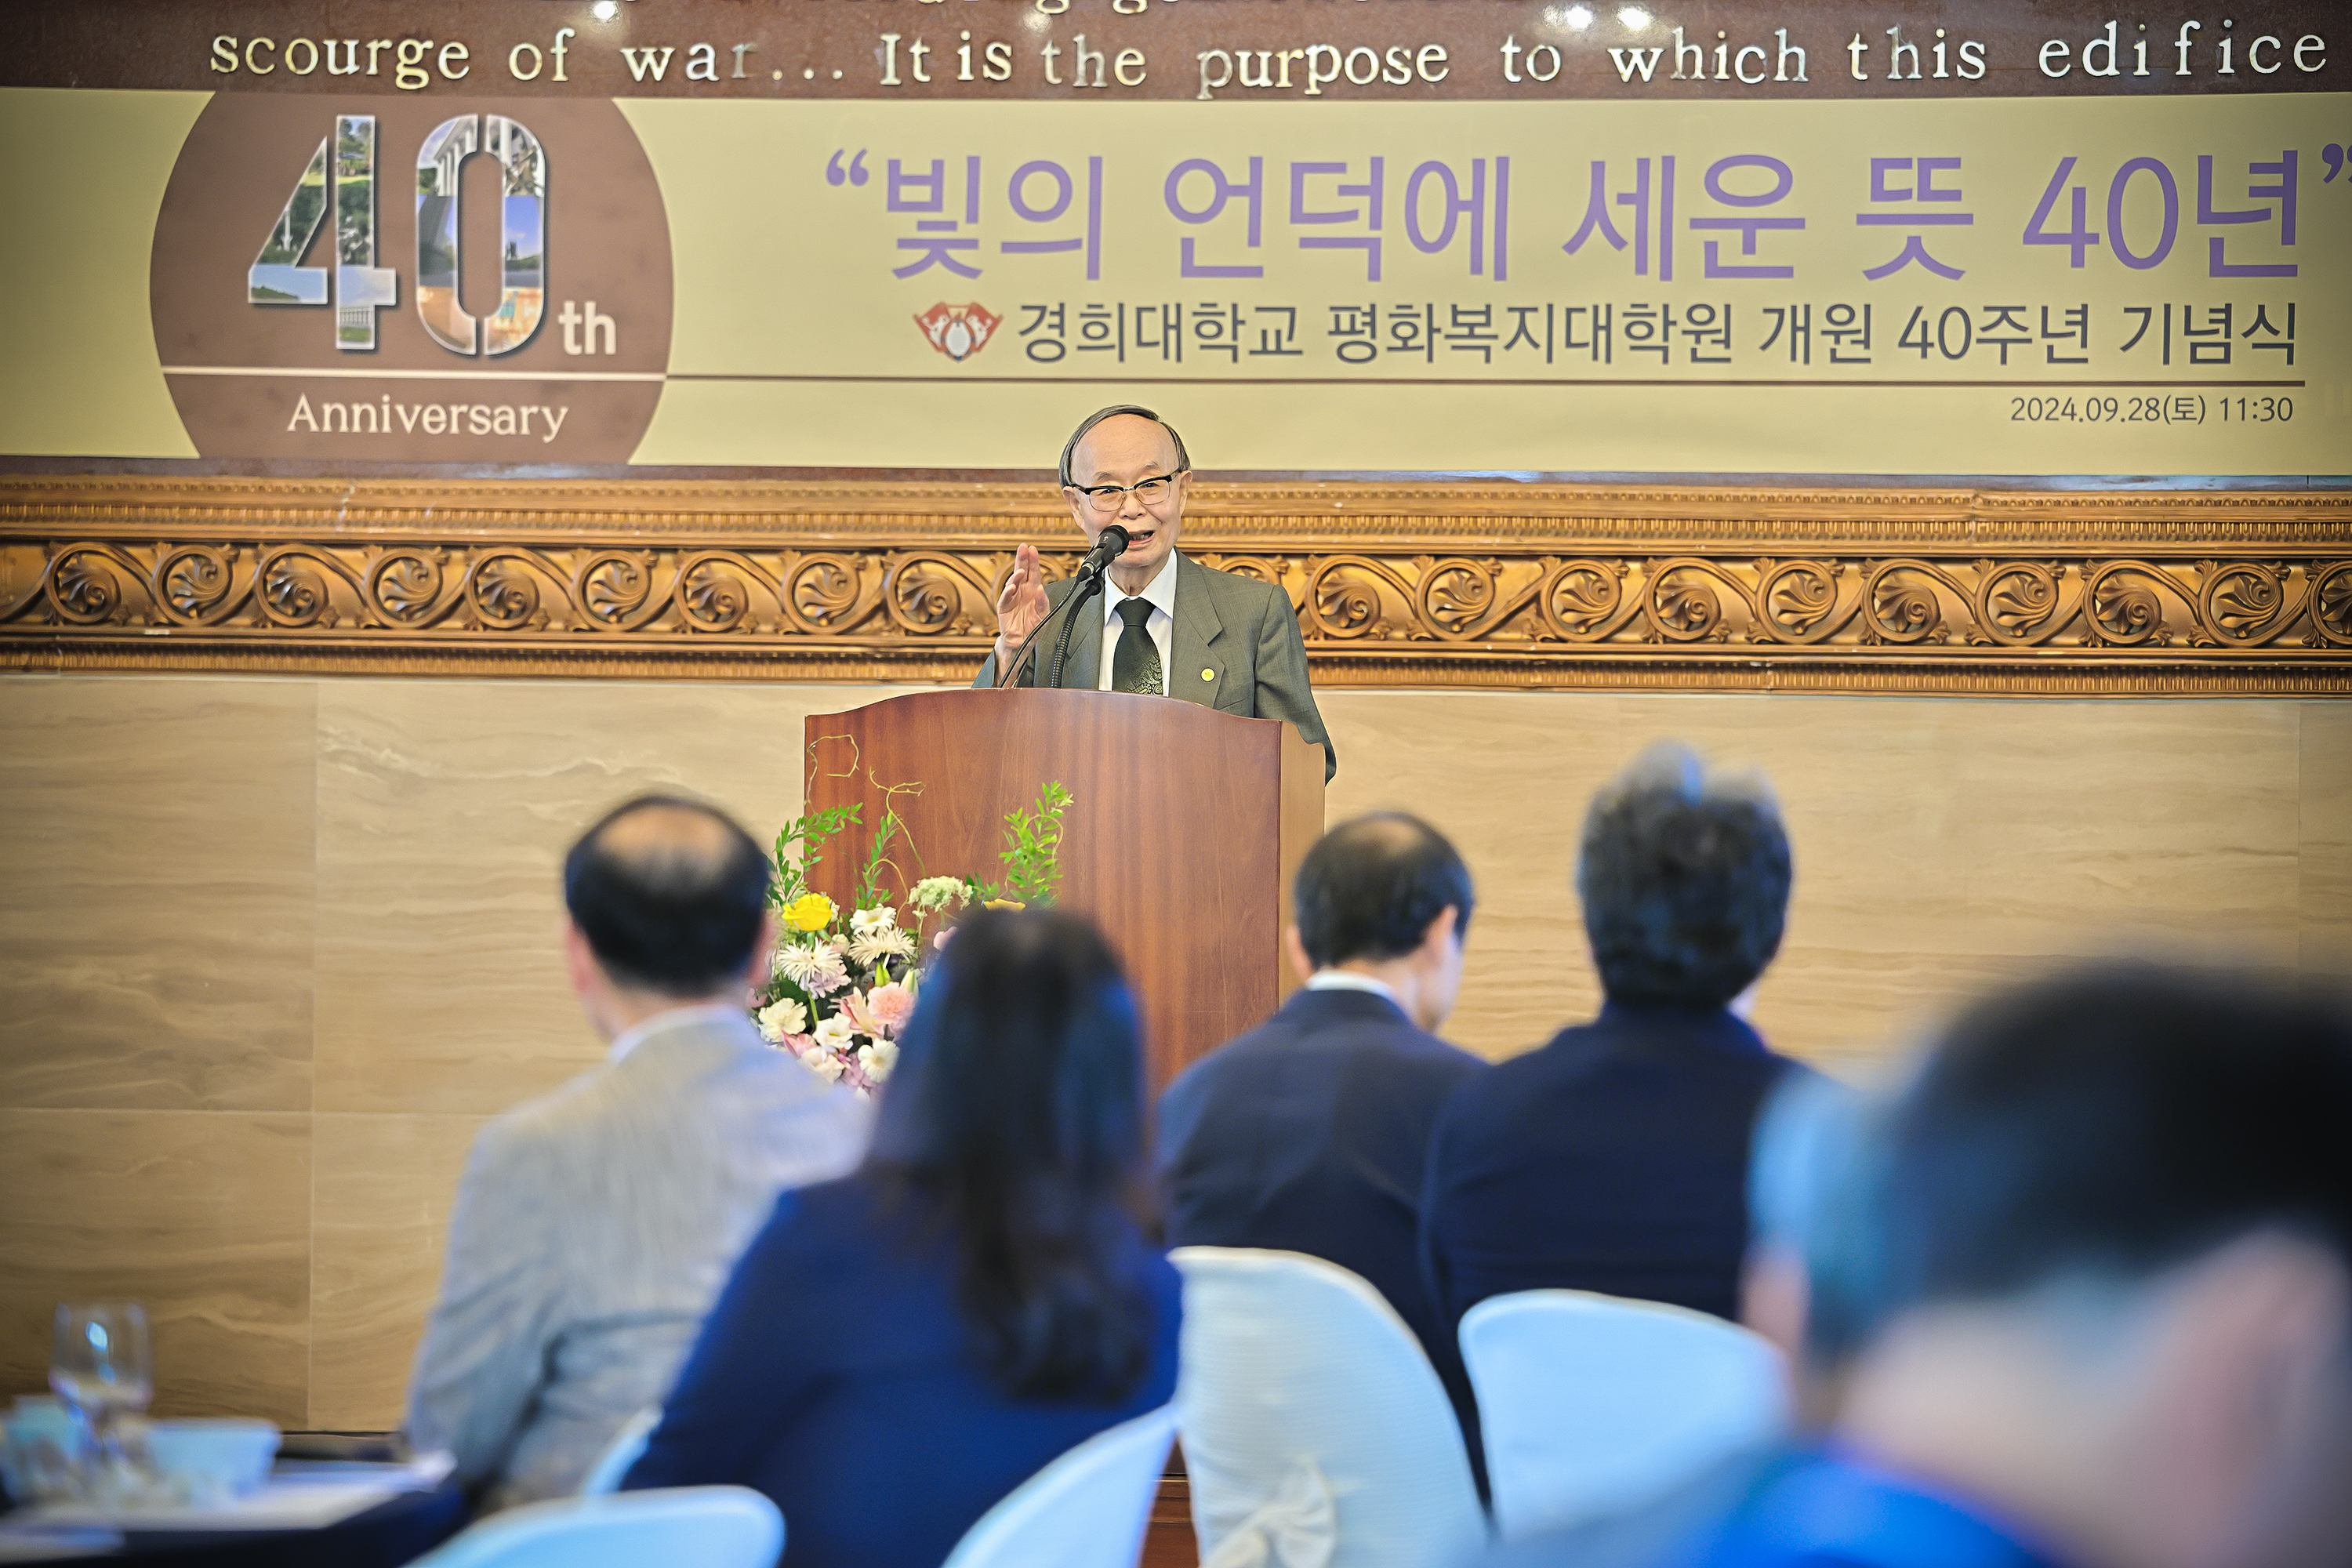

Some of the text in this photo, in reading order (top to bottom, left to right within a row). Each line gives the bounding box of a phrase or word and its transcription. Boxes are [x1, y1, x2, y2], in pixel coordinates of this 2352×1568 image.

[209, 34, 470, 90] scourge
[509, 28, 576, 82] of
[880, 32, 932, 85] It
[956, 31, 1014, 82] is
[1040, 34, 1148, 88] the
[1196, 43, 1450, 100] purpose
[1500, 34, 1561, 83] to
[1608, 27, 1809, 83] which
[1849, 27, 1987, 81] this
[2038, 20, 2327, 77] edifice
[825, 149, 1103, 281] “빛의
[1163, 156, 1510, 282] 언덕에
[1561, 154, 1806, 281] 세운
[1856, 156, 1974, 281] 뜻
[1018, 302, 2296, 366] 경희대학교 평화복지대학원 개원 40주년 기념식
[287, 394, 568, 443] Anniversary
[2011, 395, 2293, 425] 2024.09.28(토) 11:30
